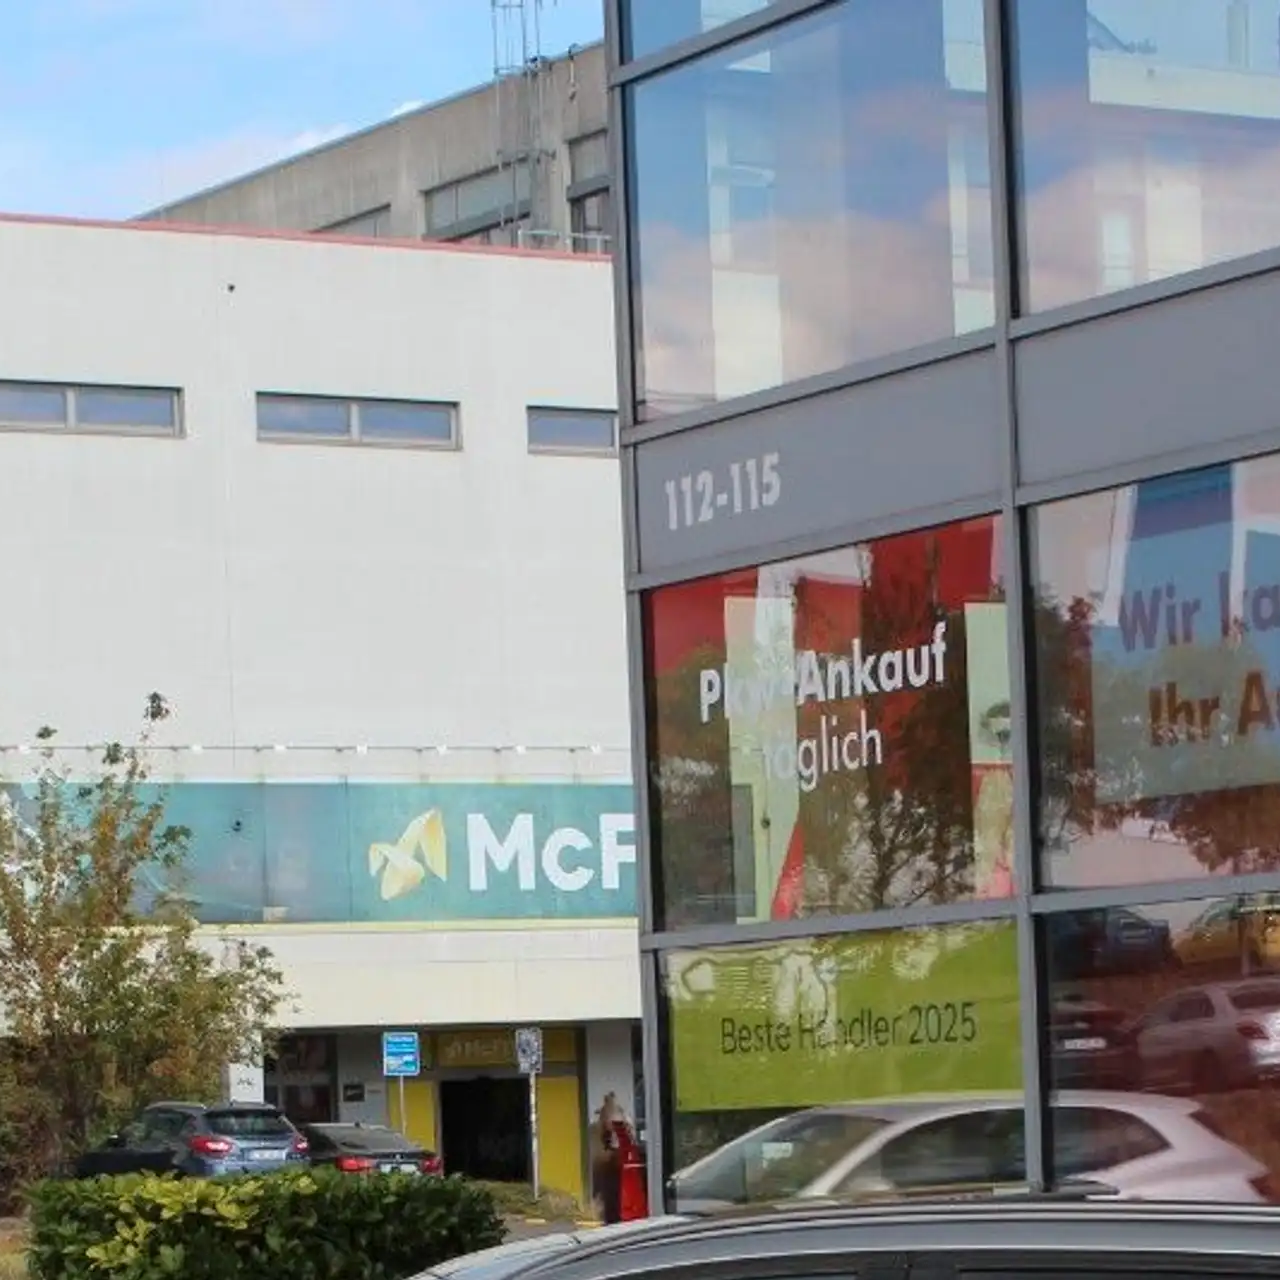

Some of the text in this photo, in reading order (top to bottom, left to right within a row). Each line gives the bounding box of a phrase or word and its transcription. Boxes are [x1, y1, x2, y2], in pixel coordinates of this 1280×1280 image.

[664, 452, 781, 531] 112-115
[1120, 580, 1201, 651] Wir
[1149, 680, 1220, 748] Ihr
[466, 811, 637, 892] McF
[721, 1016, 792, 1056] Beste
[908, 1002, 977, 1046] 2025
